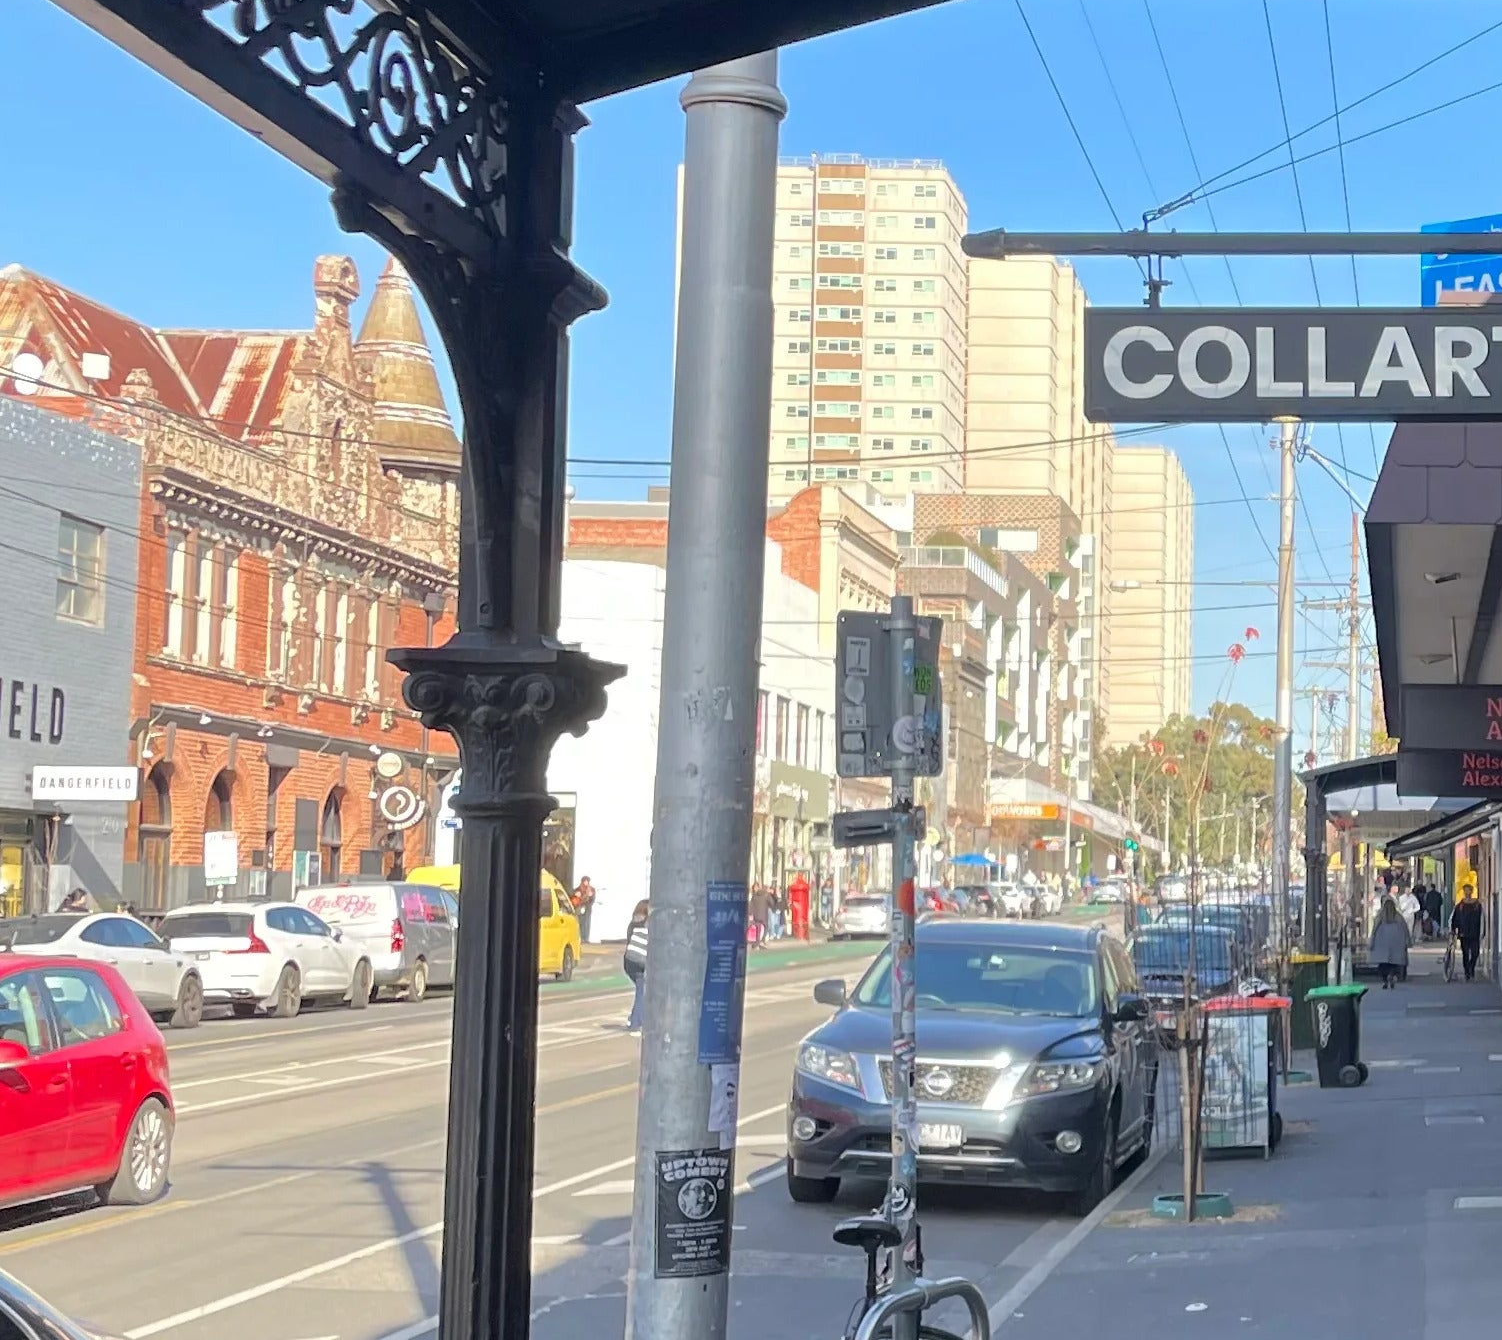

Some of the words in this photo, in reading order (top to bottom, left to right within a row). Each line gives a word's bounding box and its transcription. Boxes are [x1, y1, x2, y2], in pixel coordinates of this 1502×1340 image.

[39, 776, 132, 789] DANGERFIELD
[661, 1156, 729, 1172] UPTOWN
[663, 1166, 727, 1182] COMEDY
